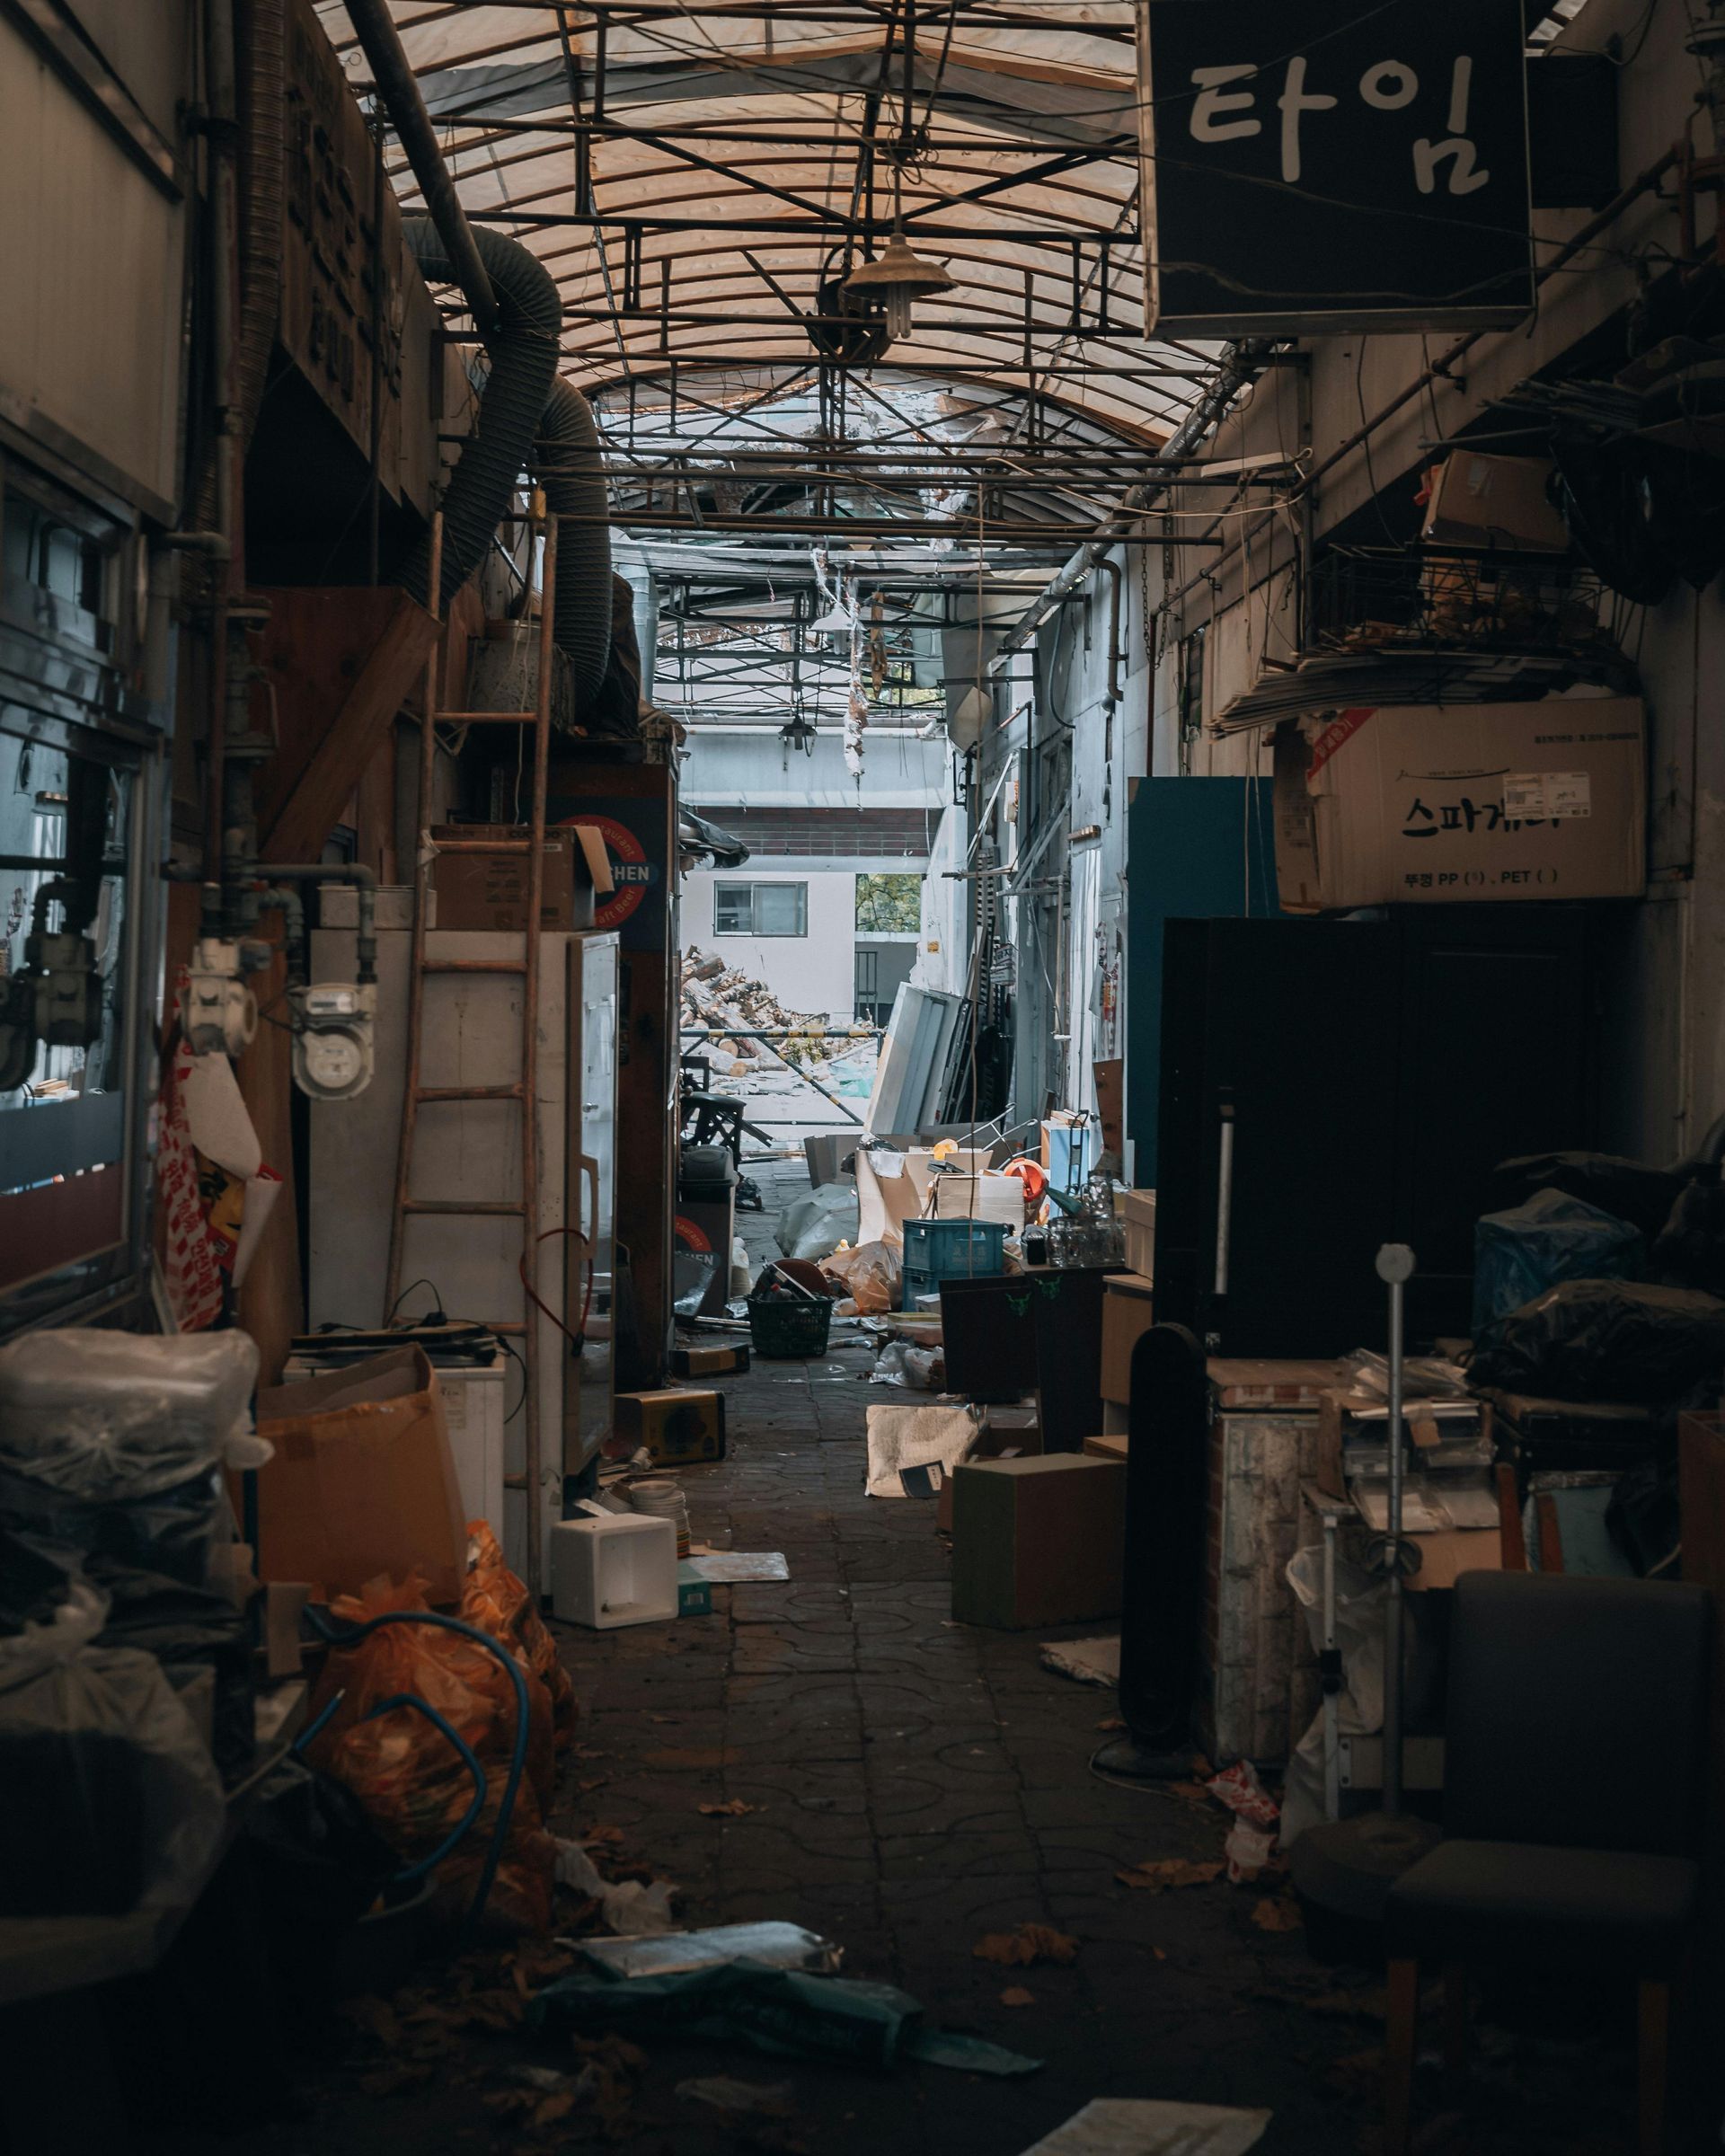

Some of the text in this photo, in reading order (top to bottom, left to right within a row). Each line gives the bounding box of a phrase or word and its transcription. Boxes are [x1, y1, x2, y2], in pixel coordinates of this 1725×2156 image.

[1190, 55, 1490, 195] 타임
[1402, 798, 1561, 837] 스파게
[610, 865, 650, 880] HEN
[1438, 872, 1459, 886] PP
[1500, 870, 1531, 884] PET
